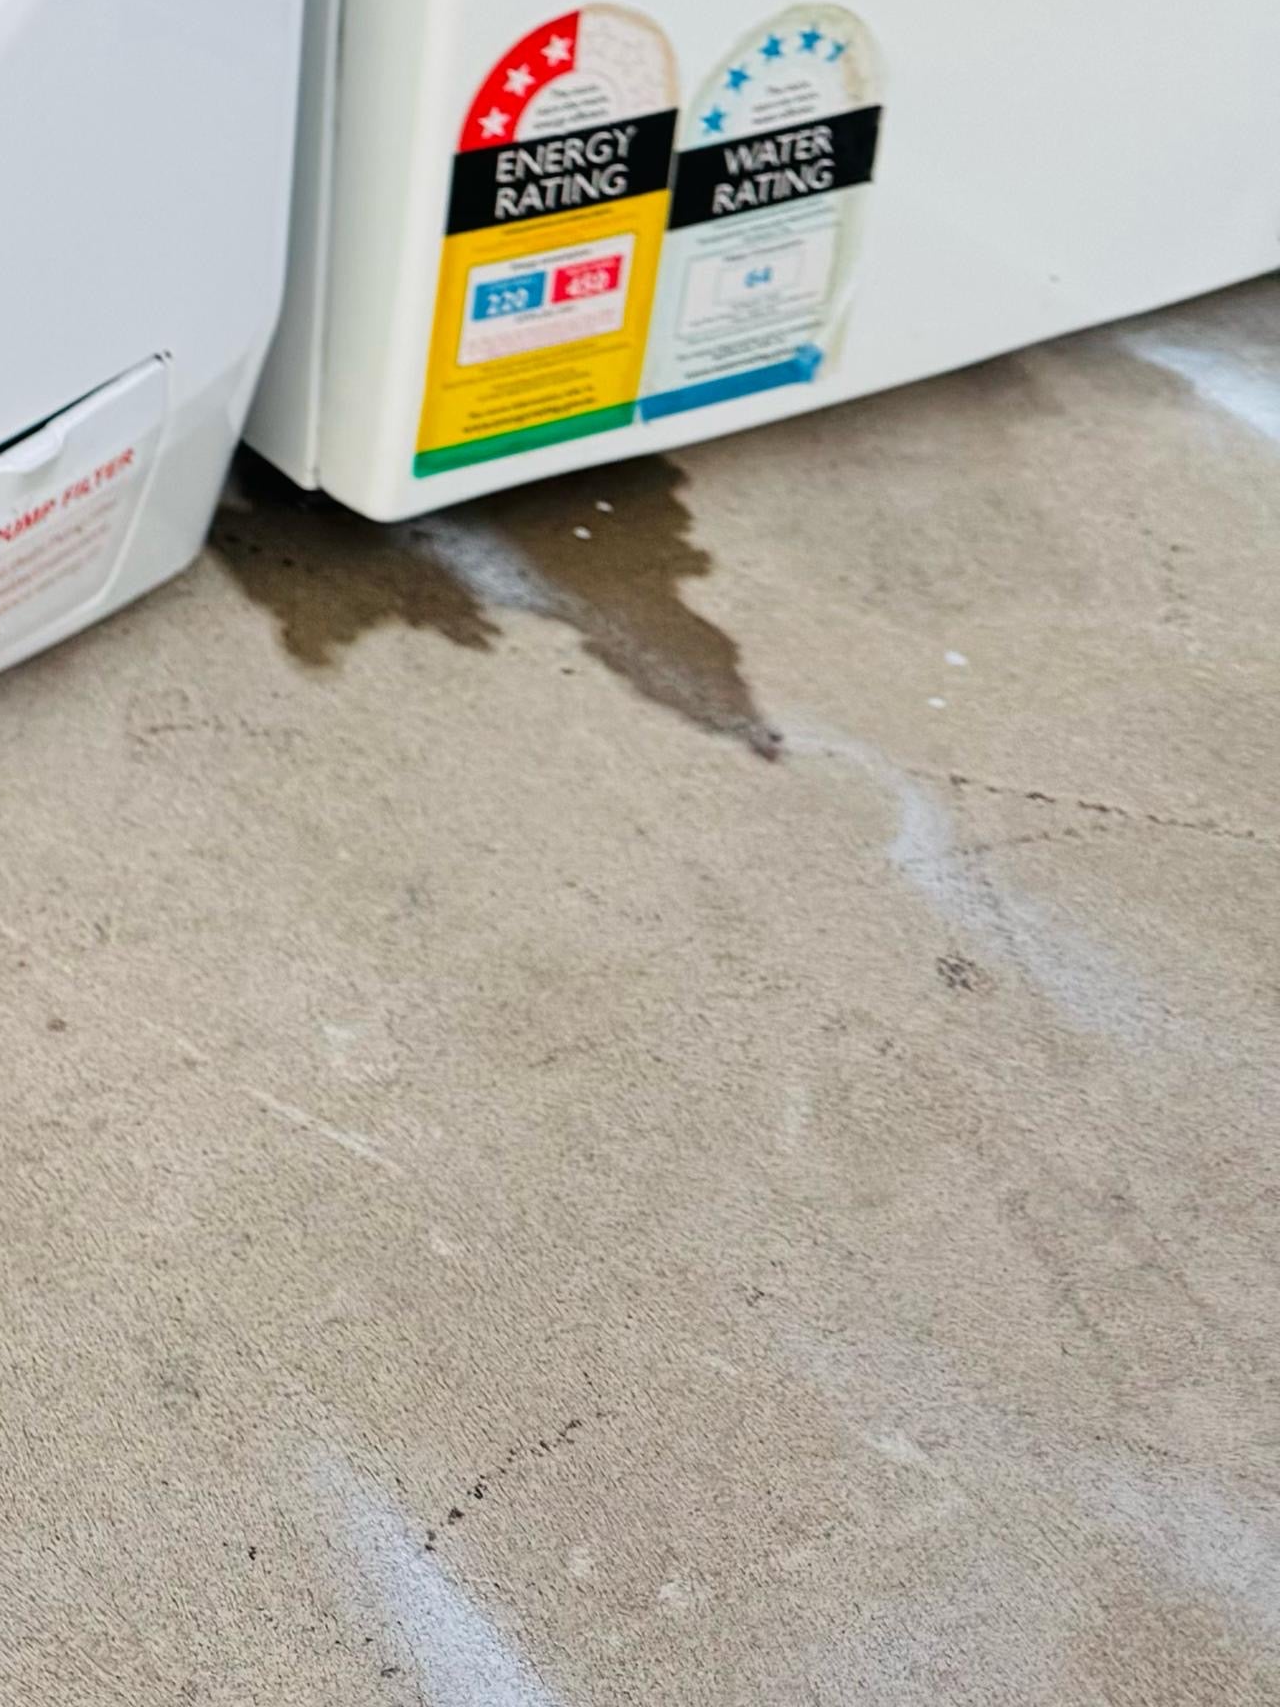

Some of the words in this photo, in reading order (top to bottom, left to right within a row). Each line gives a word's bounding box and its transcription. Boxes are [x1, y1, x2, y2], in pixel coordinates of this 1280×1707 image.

[495, 125, 639, 184] ENERGY
[723, 125, 834, 176] WATER
[493, 163, 629, 220] RATING
[711, 158, 836, 214] RATING
[61, 448, 135, 507] FILTER
